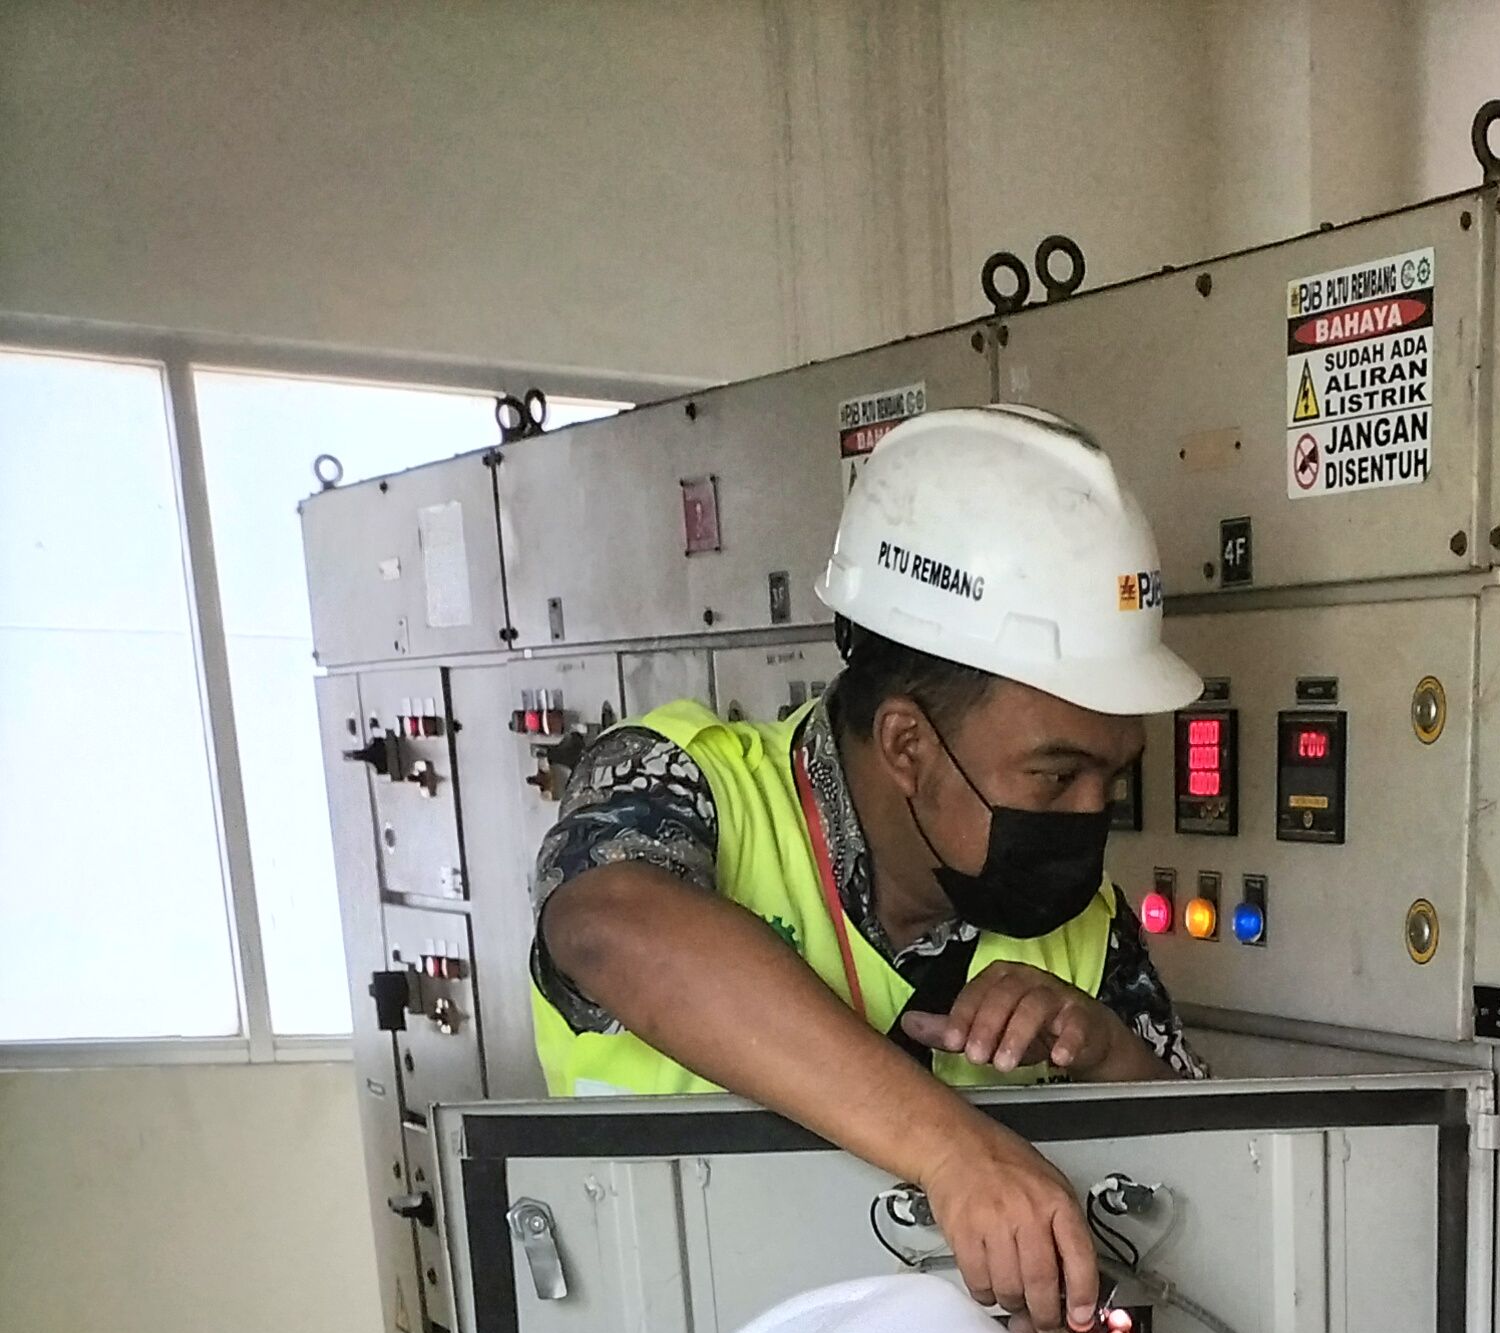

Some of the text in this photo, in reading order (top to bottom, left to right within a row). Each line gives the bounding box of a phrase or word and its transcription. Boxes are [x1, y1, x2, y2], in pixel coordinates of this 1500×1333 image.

[1300, 264, 1397, 314] PJB PLTU REMBANG
[1315, 303, 1403, 343] BAHAYA
[1325, 335, 1427, 371] SUDAH ADA
[1324, 359, 1427, 395] ALIRAN
[1324, 382, 1427, 417] LISTRIK
[1324, 411, 1427, 455] JANGAN
[1325, 447, 1427, 489] DISENTUH
[877, 540, 985, 601] PLTU REMBANG
[1224, 537, 1246, 566] 4F
